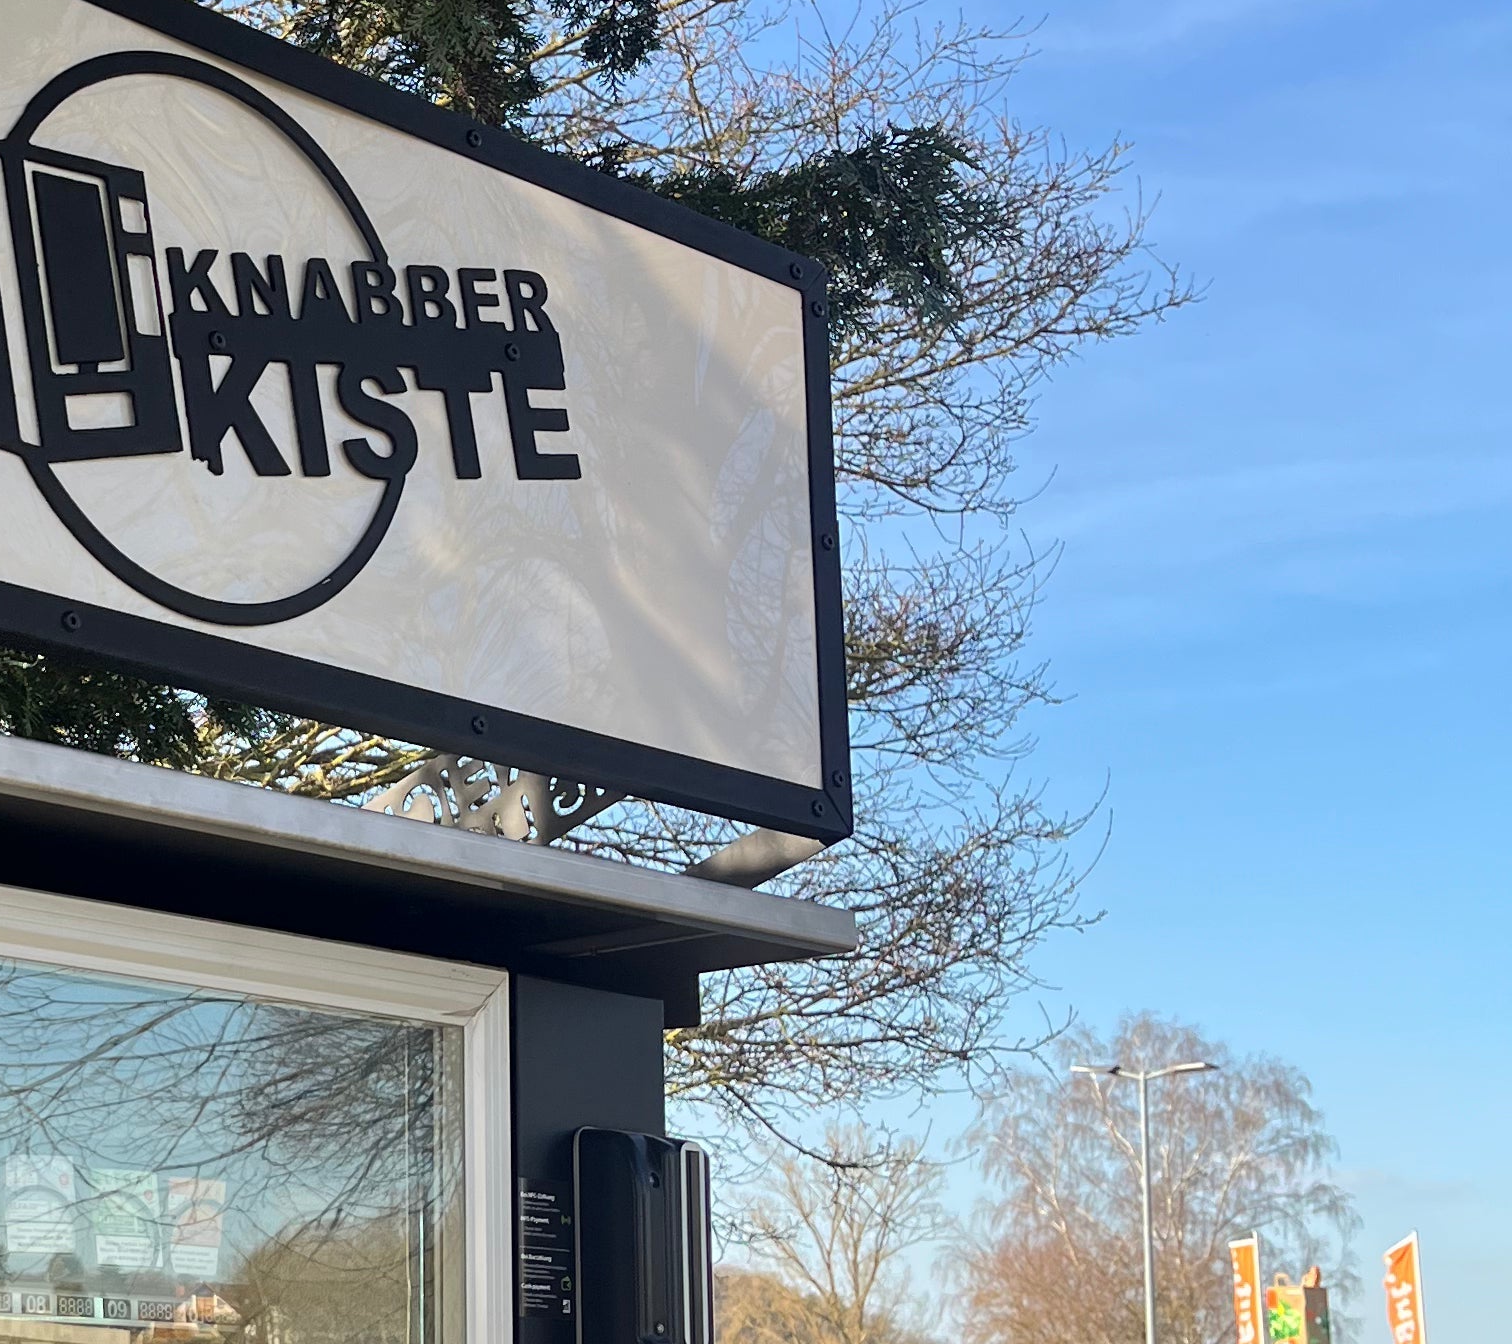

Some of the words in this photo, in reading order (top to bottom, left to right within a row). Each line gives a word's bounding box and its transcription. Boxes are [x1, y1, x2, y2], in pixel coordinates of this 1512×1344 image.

[166, 247, 550, 333] KNABBER
[186, 351, 582, 480] KISTE
[26, 1295, 47, 1314] 08
[58, 1297, 93, 1316] 8888
[107, 1299, 127, 1318] 09
